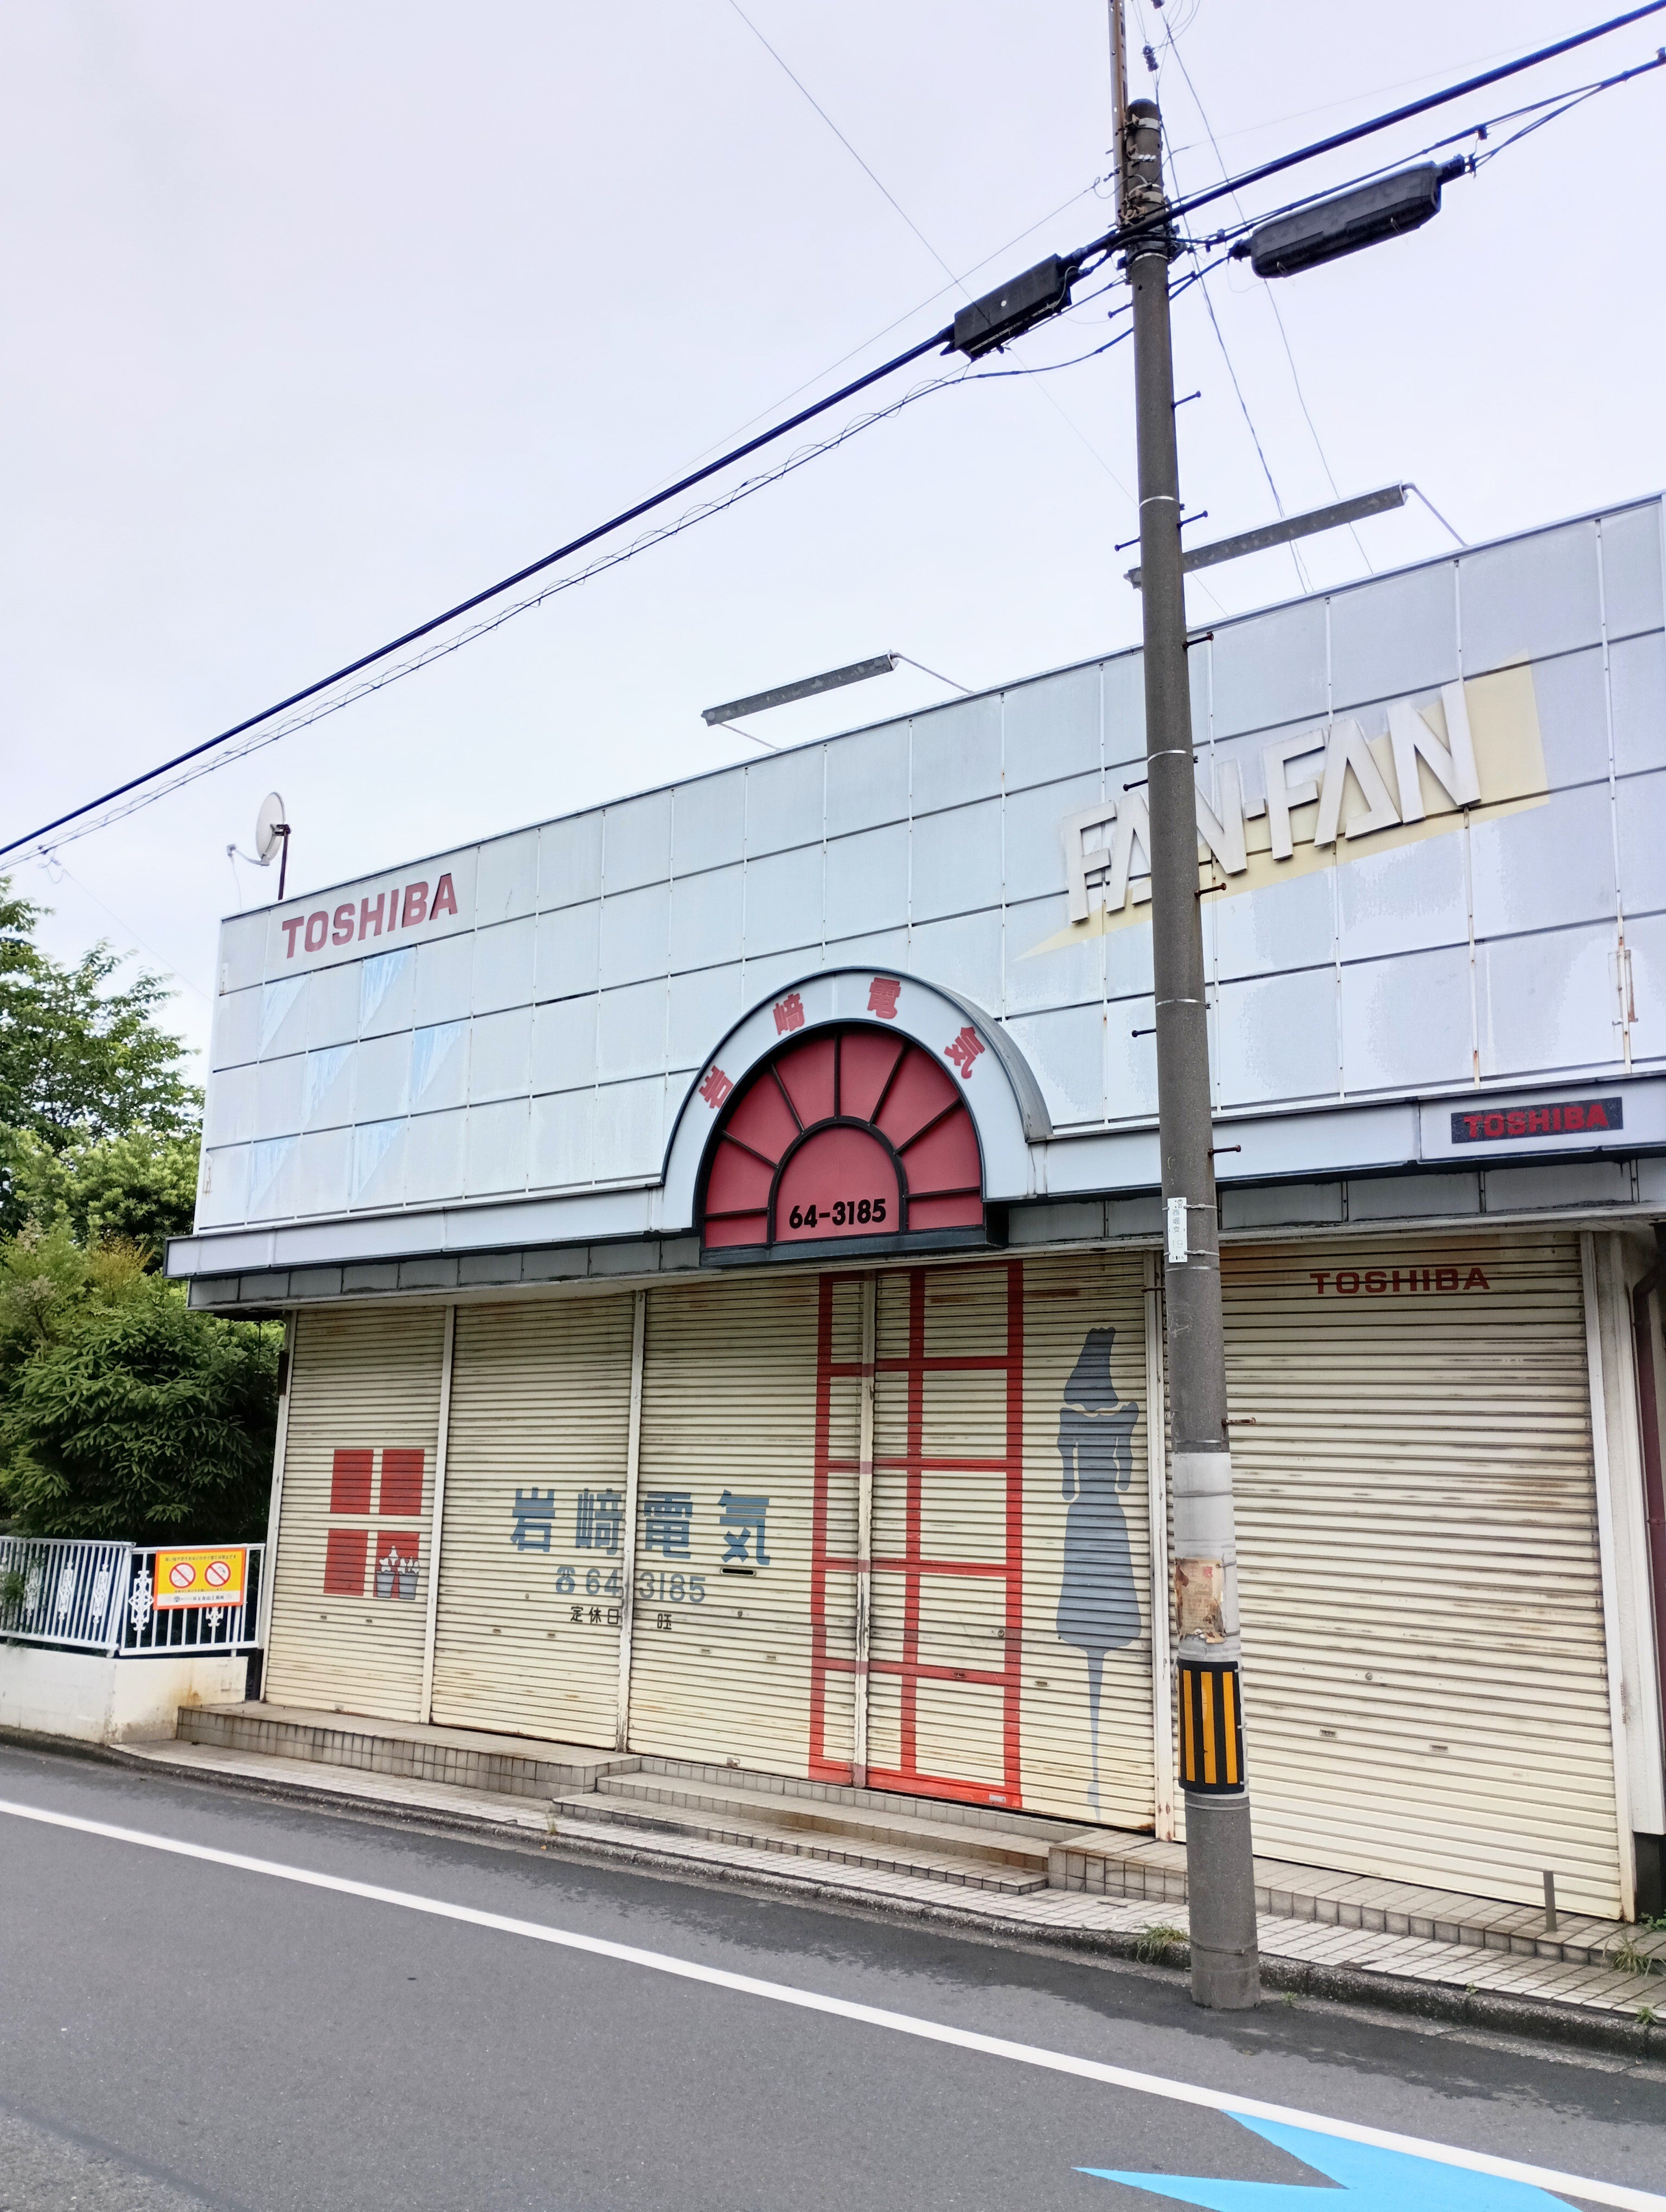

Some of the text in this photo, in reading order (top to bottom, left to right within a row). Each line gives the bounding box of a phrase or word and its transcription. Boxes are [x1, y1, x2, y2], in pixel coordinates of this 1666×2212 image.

[282, 873, 458, 959] TOSHIBA
[1463, 1104, 1609, 1138] TOSHIBA
[789, 1198, 887, 1229] 64-3185
[1309, 1267, 1490, 1295] TOSHIBA
